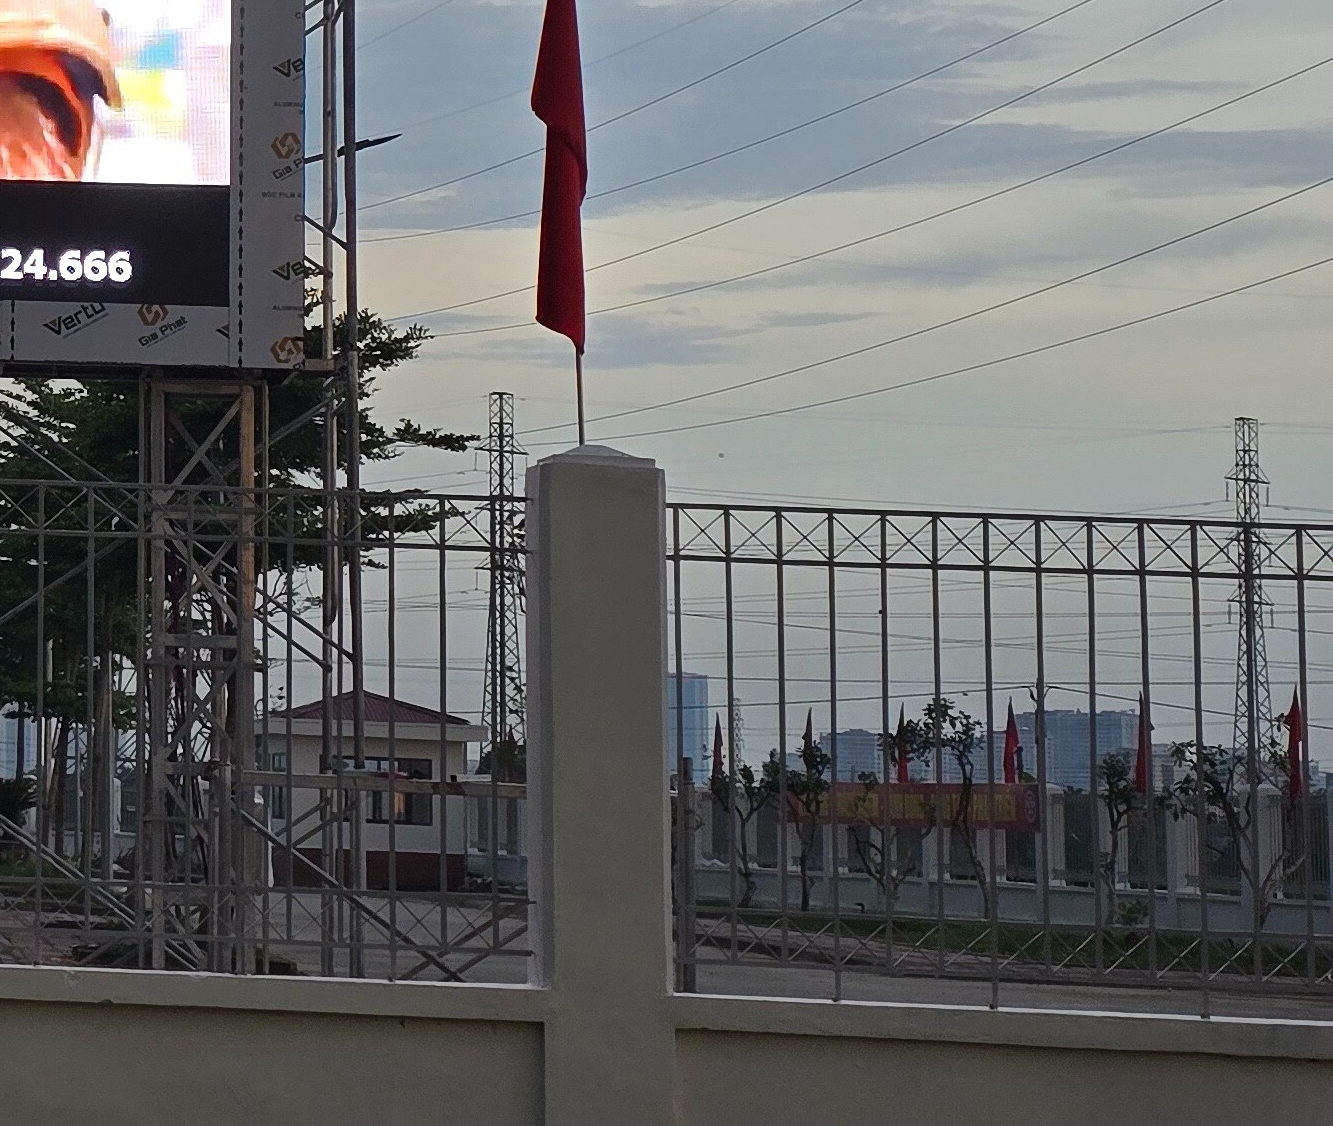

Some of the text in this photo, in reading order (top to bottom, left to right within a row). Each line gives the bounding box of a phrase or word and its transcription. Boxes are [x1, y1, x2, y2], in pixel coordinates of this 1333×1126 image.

[42, 301, 106, 336] Vertu
[137, 315, 189, 348] Gia Phat
